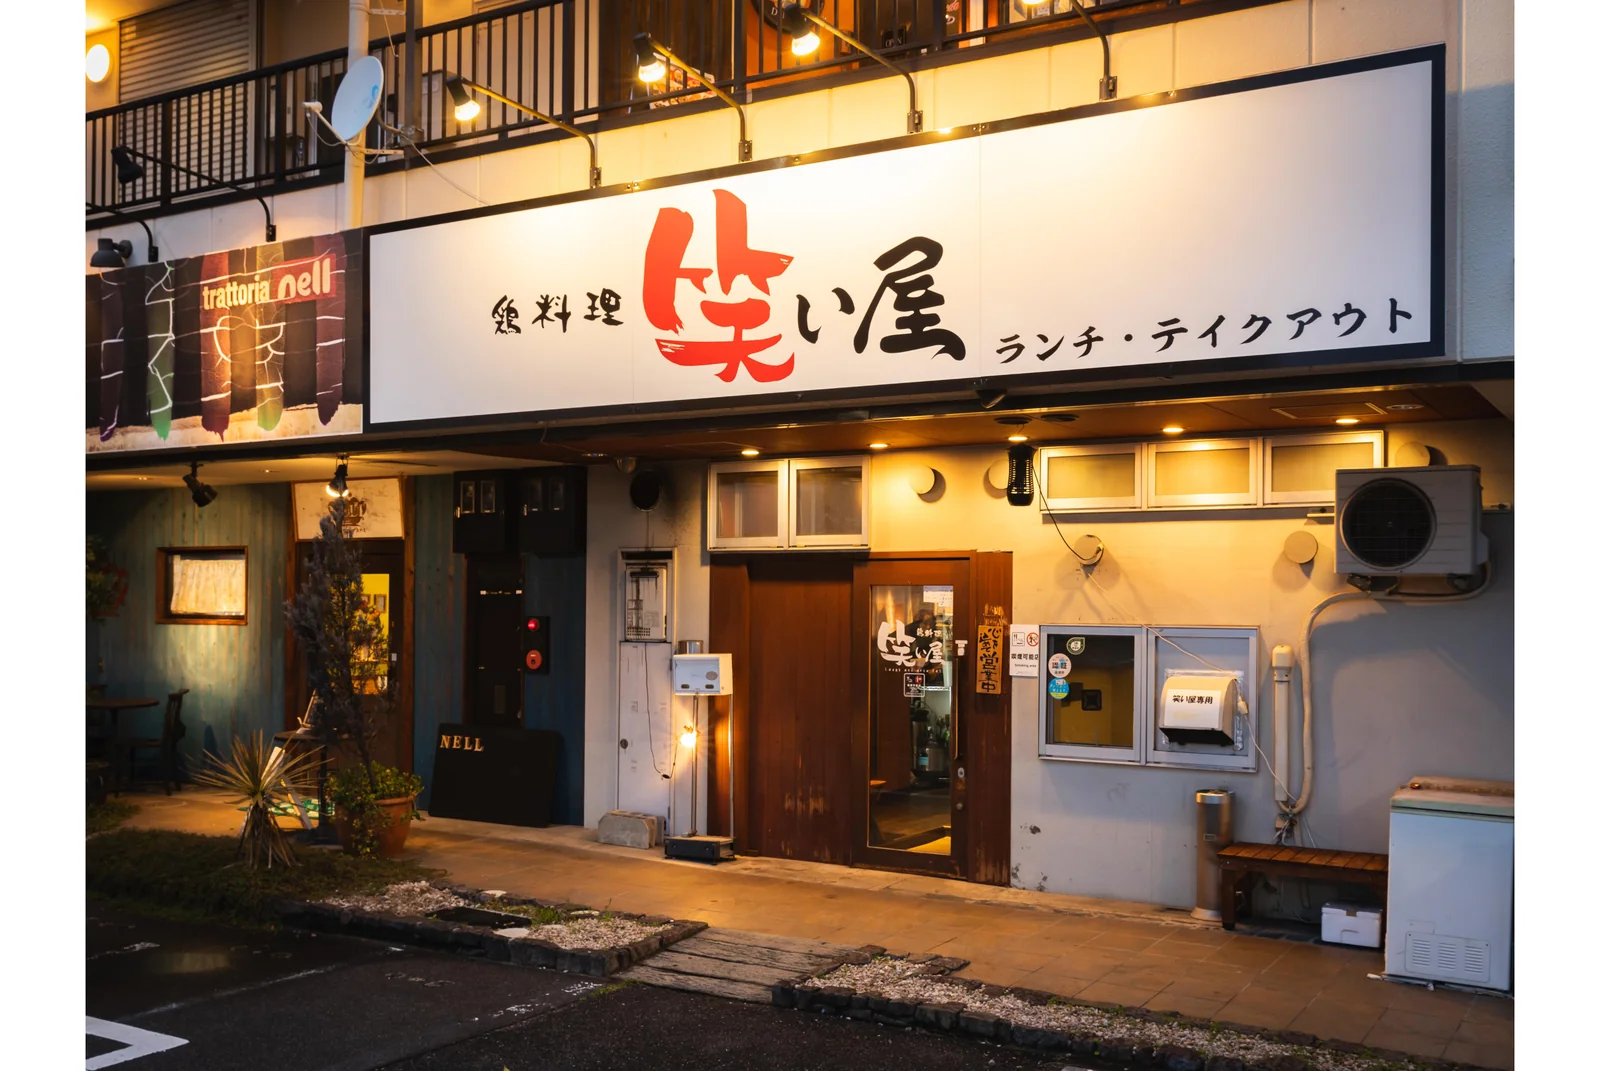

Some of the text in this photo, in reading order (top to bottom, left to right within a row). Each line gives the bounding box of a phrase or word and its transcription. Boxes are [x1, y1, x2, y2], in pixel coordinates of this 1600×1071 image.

[202, 257, 332, 310] trattoria nell
[641, 188, 966, 383] 笑い屋
[491, 288, 624, 335] 鶏料理
[996, 297, 1413, 364] ランチ・テイクアウト
[877, 619, 946, 668] 笑い屋
[439, 734, 485, 752] NELL
